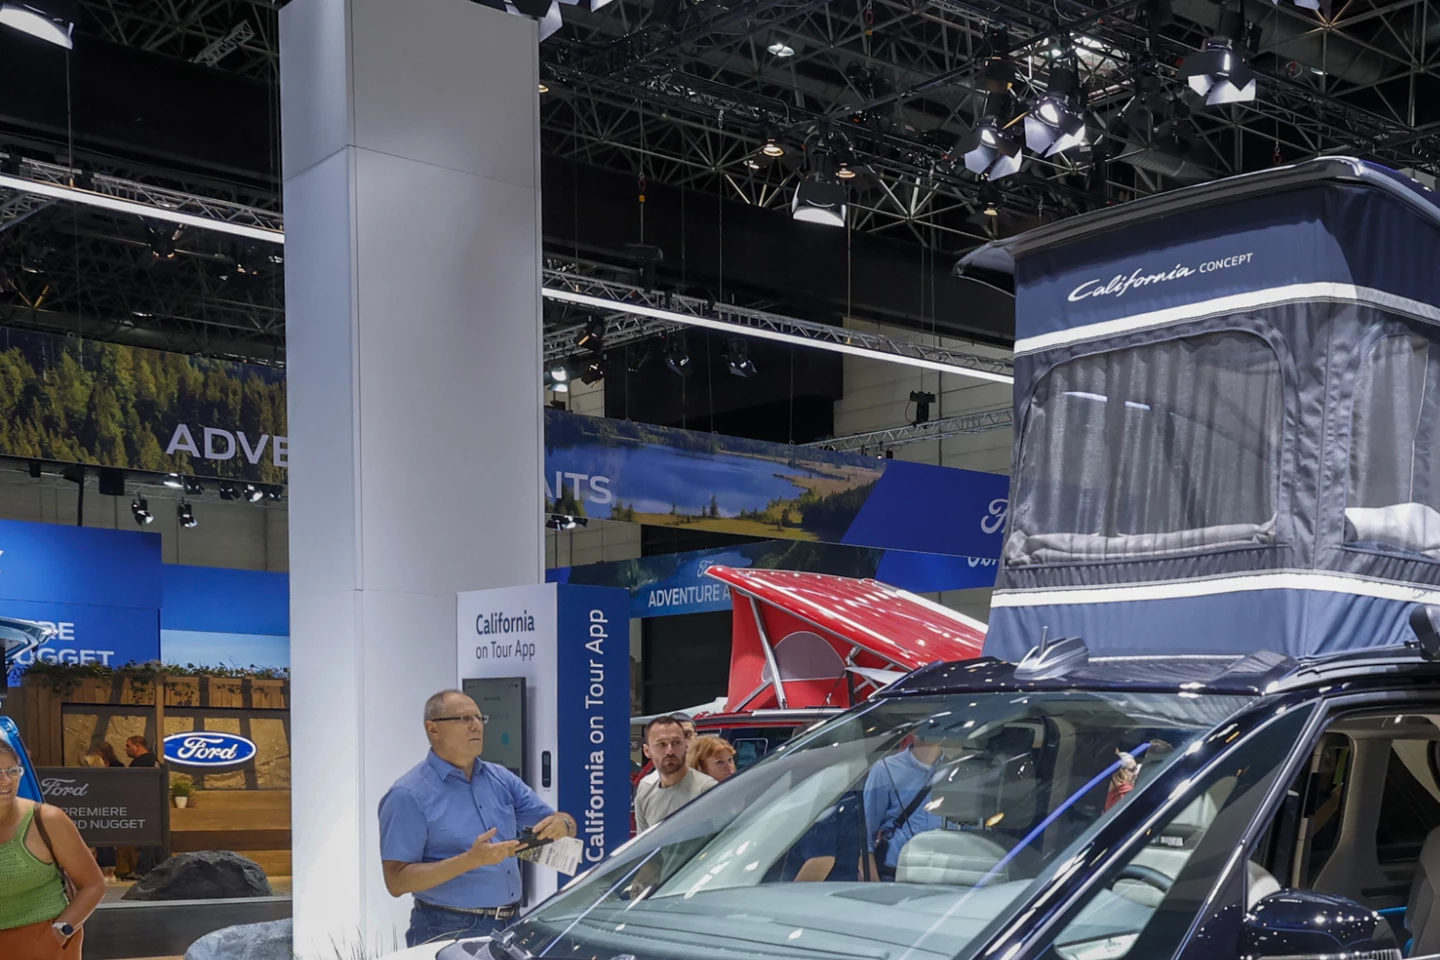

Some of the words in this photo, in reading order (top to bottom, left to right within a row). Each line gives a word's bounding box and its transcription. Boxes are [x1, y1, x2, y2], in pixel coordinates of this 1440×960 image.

[1068, 264, 1196, 302] California
[1199, 252, 1254, 273] CONCEPT
[648, 584, 720, 608] ADVENTURE
[475, 610, 535, 635] California
[584, 608, 609, 655] App
[475, 645, 488, 660] on
[491, 641, 513, 659] Tour
[515, 639, 536, 661] App
[584, 659, 605, 710] Tour
[589, 715, 605, 745] on
[177, 736, 239, 760] Ford
[41, 777, 90, 797] Ford
[584, 750, 605, 864] California
[90, 819, 146, 829] NUGGET
